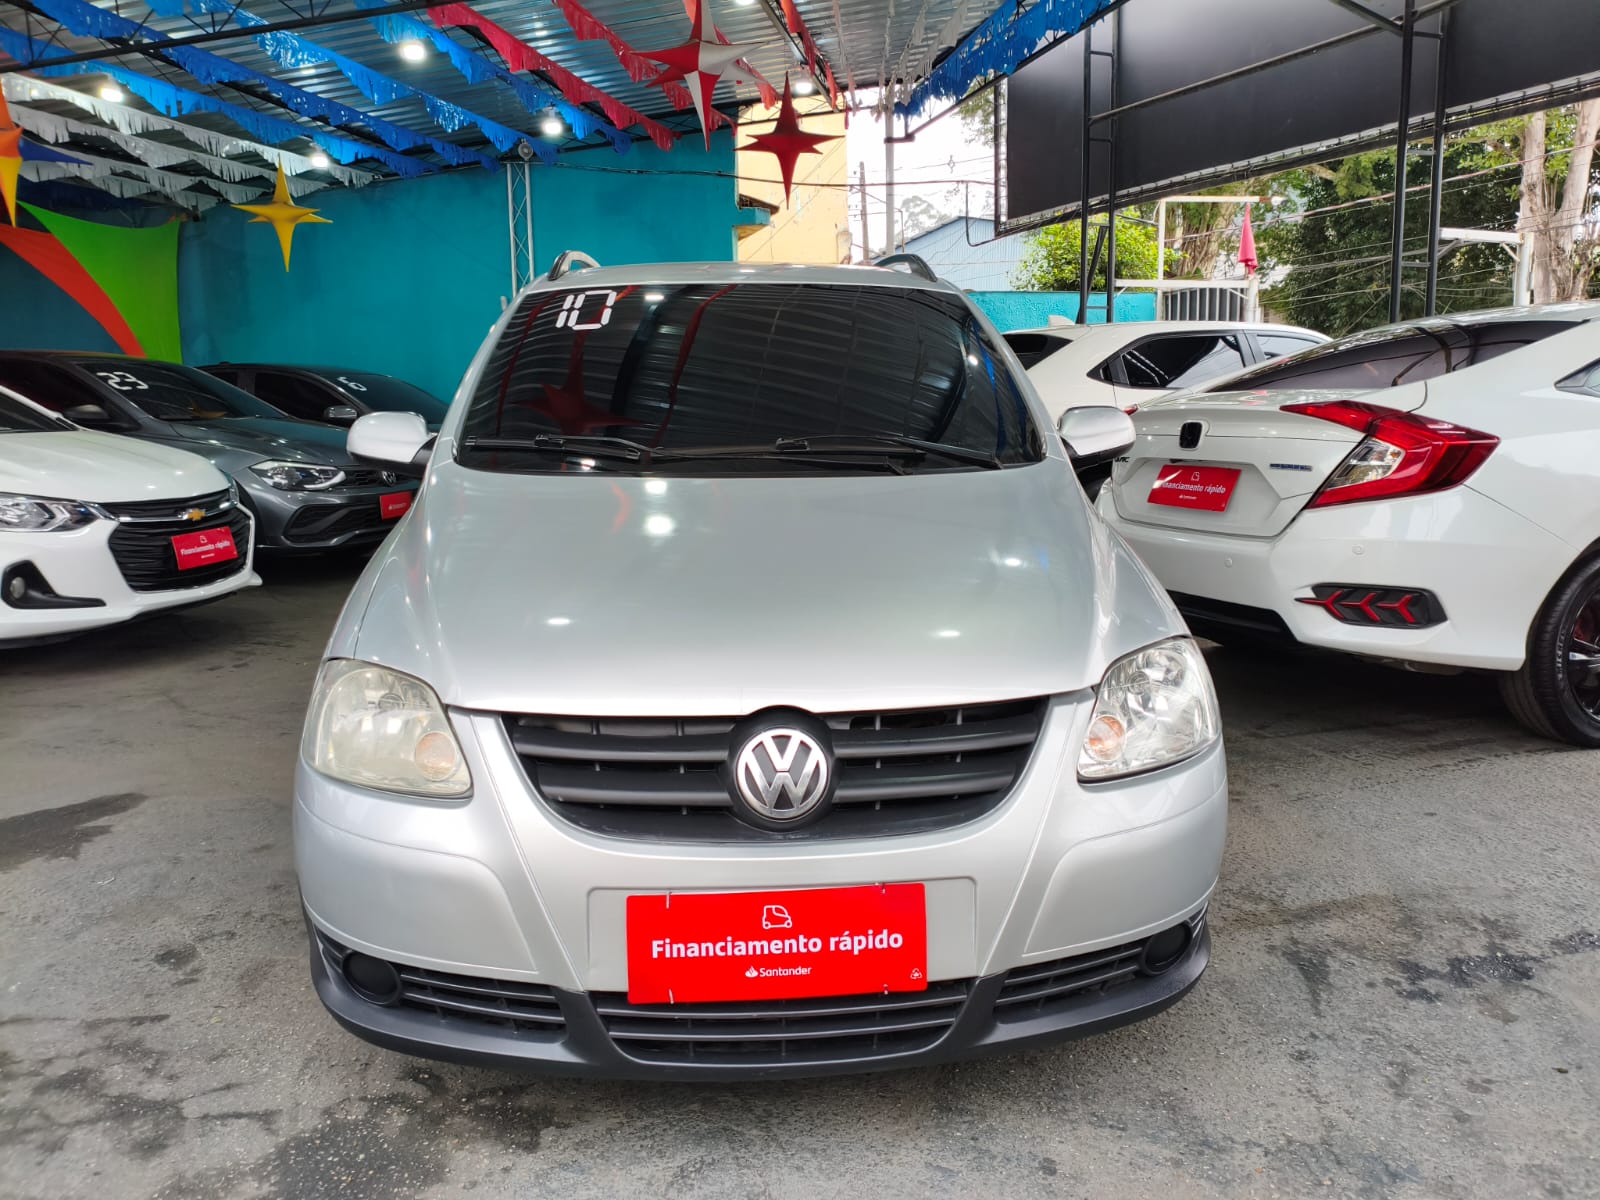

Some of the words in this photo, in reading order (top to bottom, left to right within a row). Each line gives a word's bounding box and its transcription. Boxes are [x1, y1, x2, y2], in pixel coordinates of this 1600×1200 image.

[555, 290, 617, 331] 10
[96, 371, 149, 390] 23
[1160, 481, 1204, 492] inanciamento
[736, 728, 828, 819] VW
[652, 935, 823, 959] Financiamento
[829, 929, 904, 956] rápido
[759, 965, 812, 977] Santander
